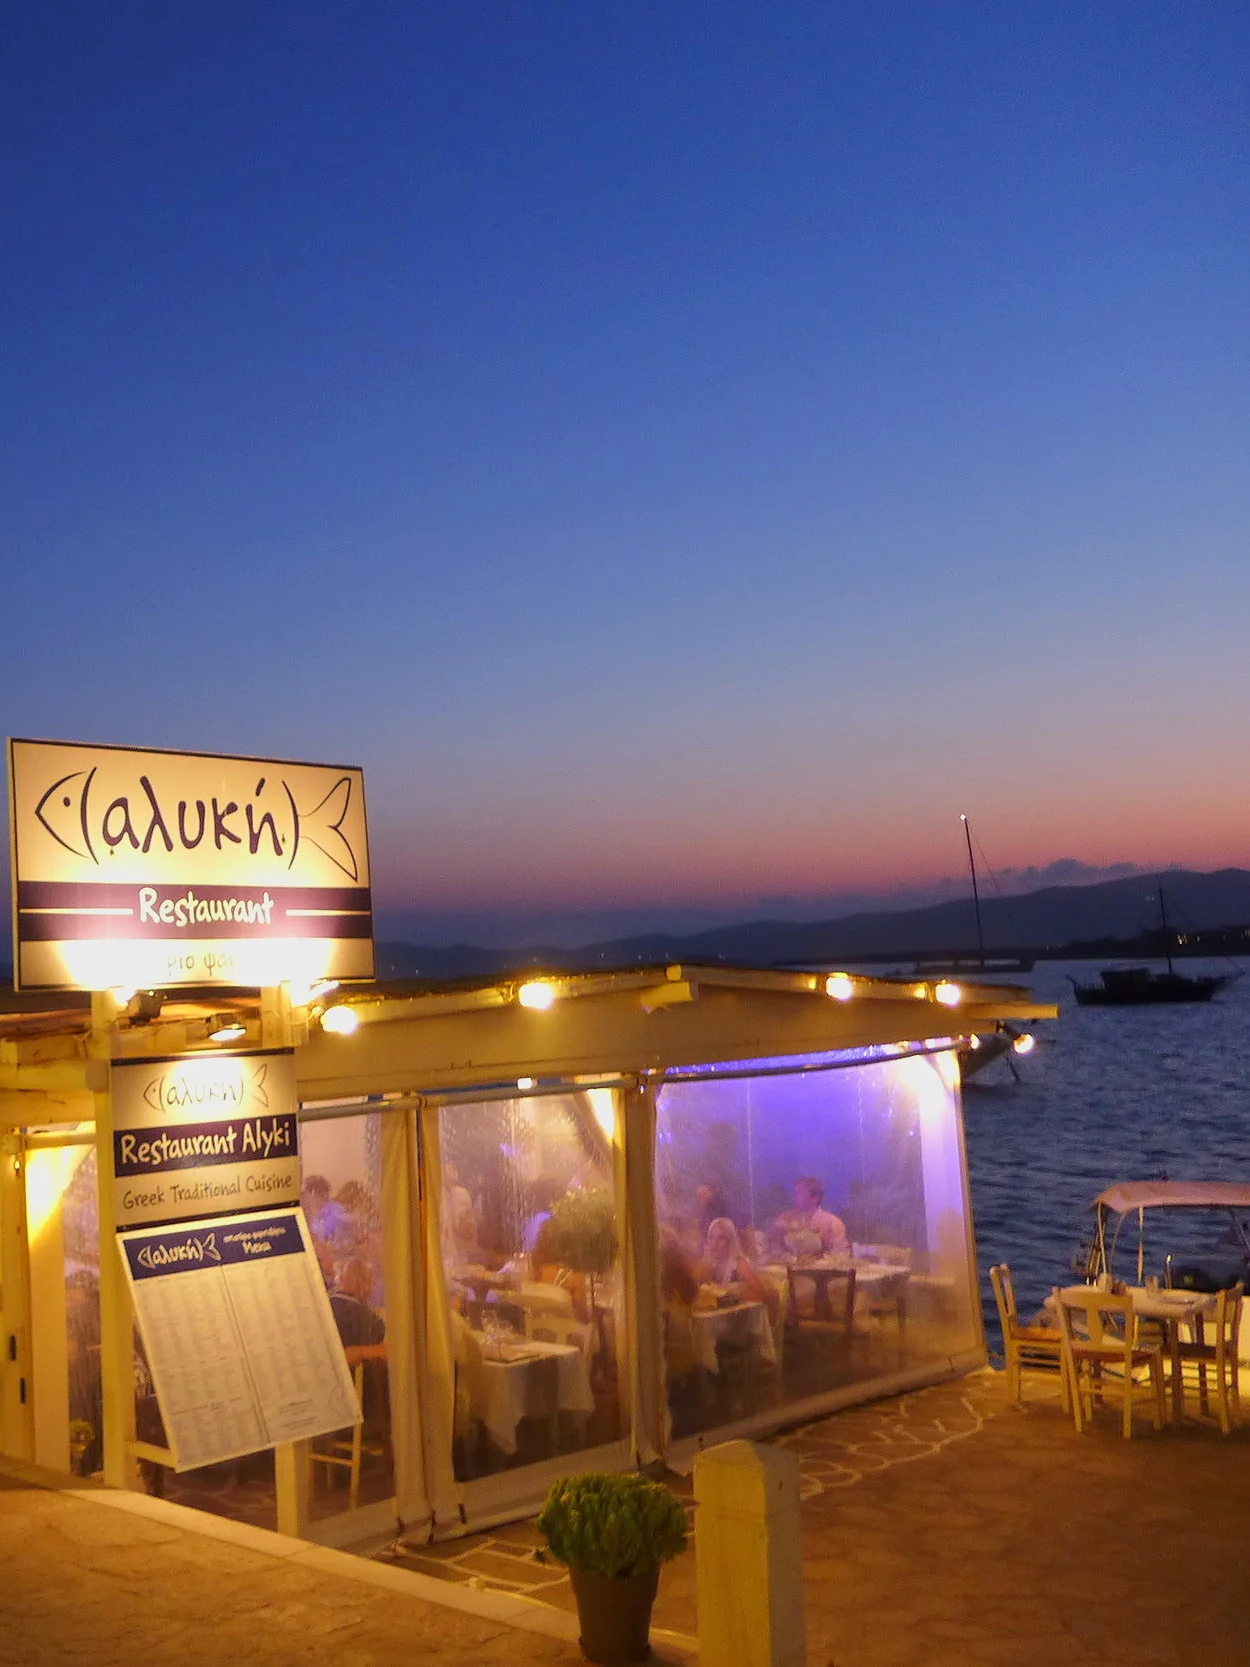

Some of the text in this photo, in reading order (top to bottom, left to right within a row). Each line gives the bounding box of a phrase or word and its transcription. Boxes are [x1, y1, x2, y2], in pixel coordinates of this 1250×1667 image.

[138, 886, 274, 927] Restaurant
[120, 1117, 291, 1165] Restaurant Alyki
[123, 1173, 292, 1209] Greek Traditional Cuisine
